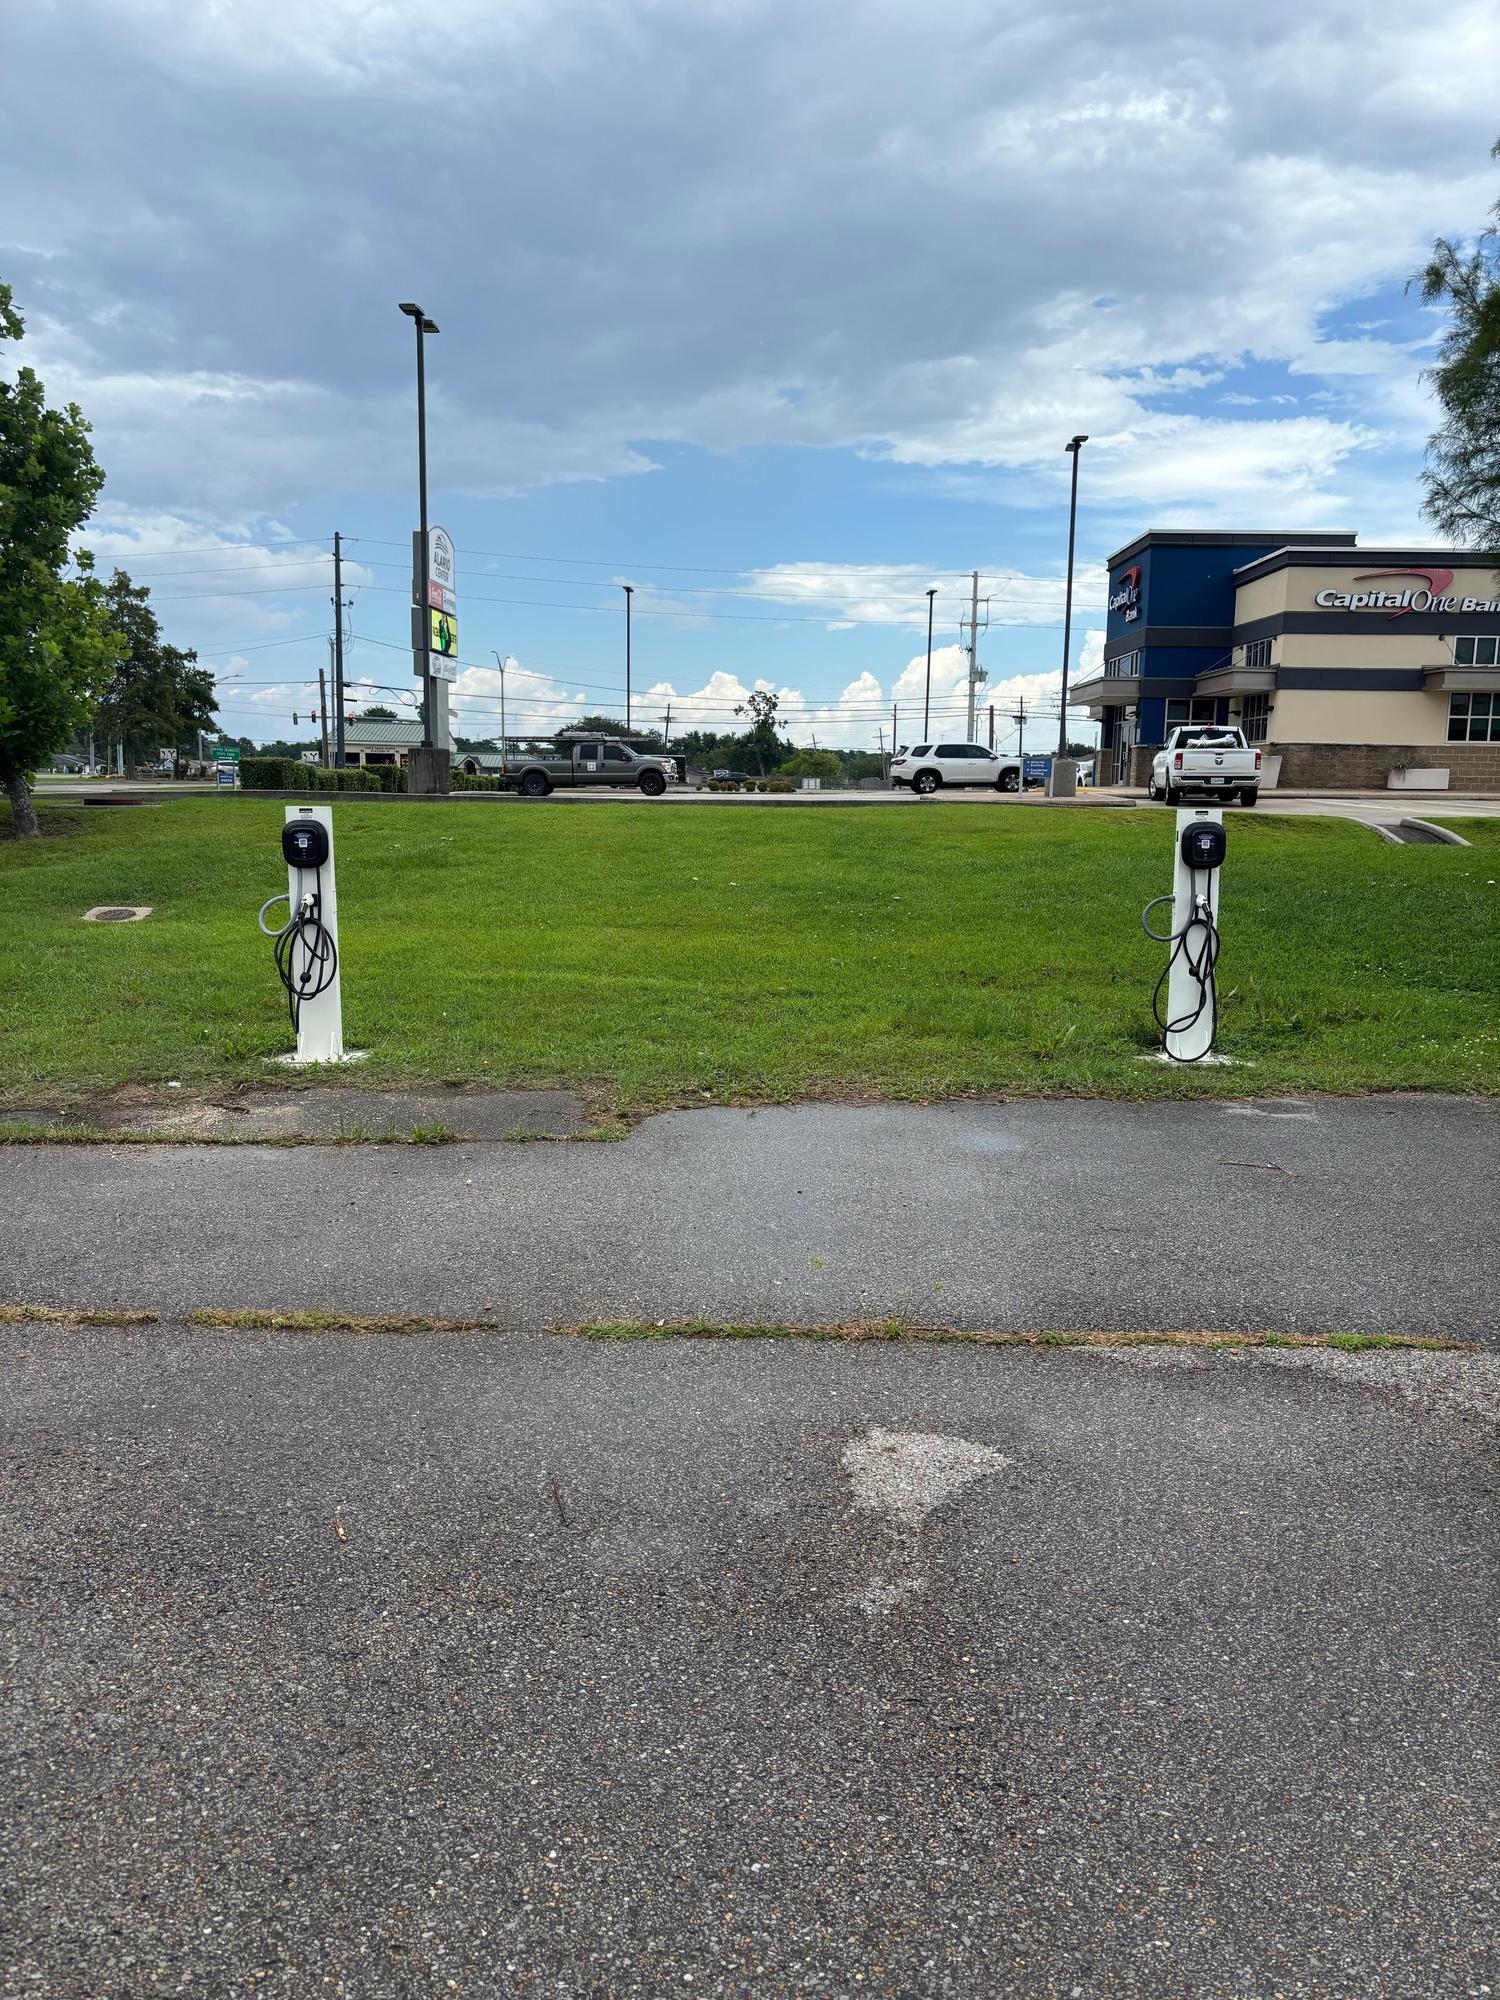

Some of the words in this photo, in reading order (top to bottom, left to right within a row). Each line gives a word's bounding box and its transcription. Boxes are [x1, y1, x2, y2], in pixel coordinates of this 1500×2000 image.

[433, 551, 450, 572] ALARIO
[435, 566, 449, 583] CENTER
[1125, 606, 1138, 623] Bank
